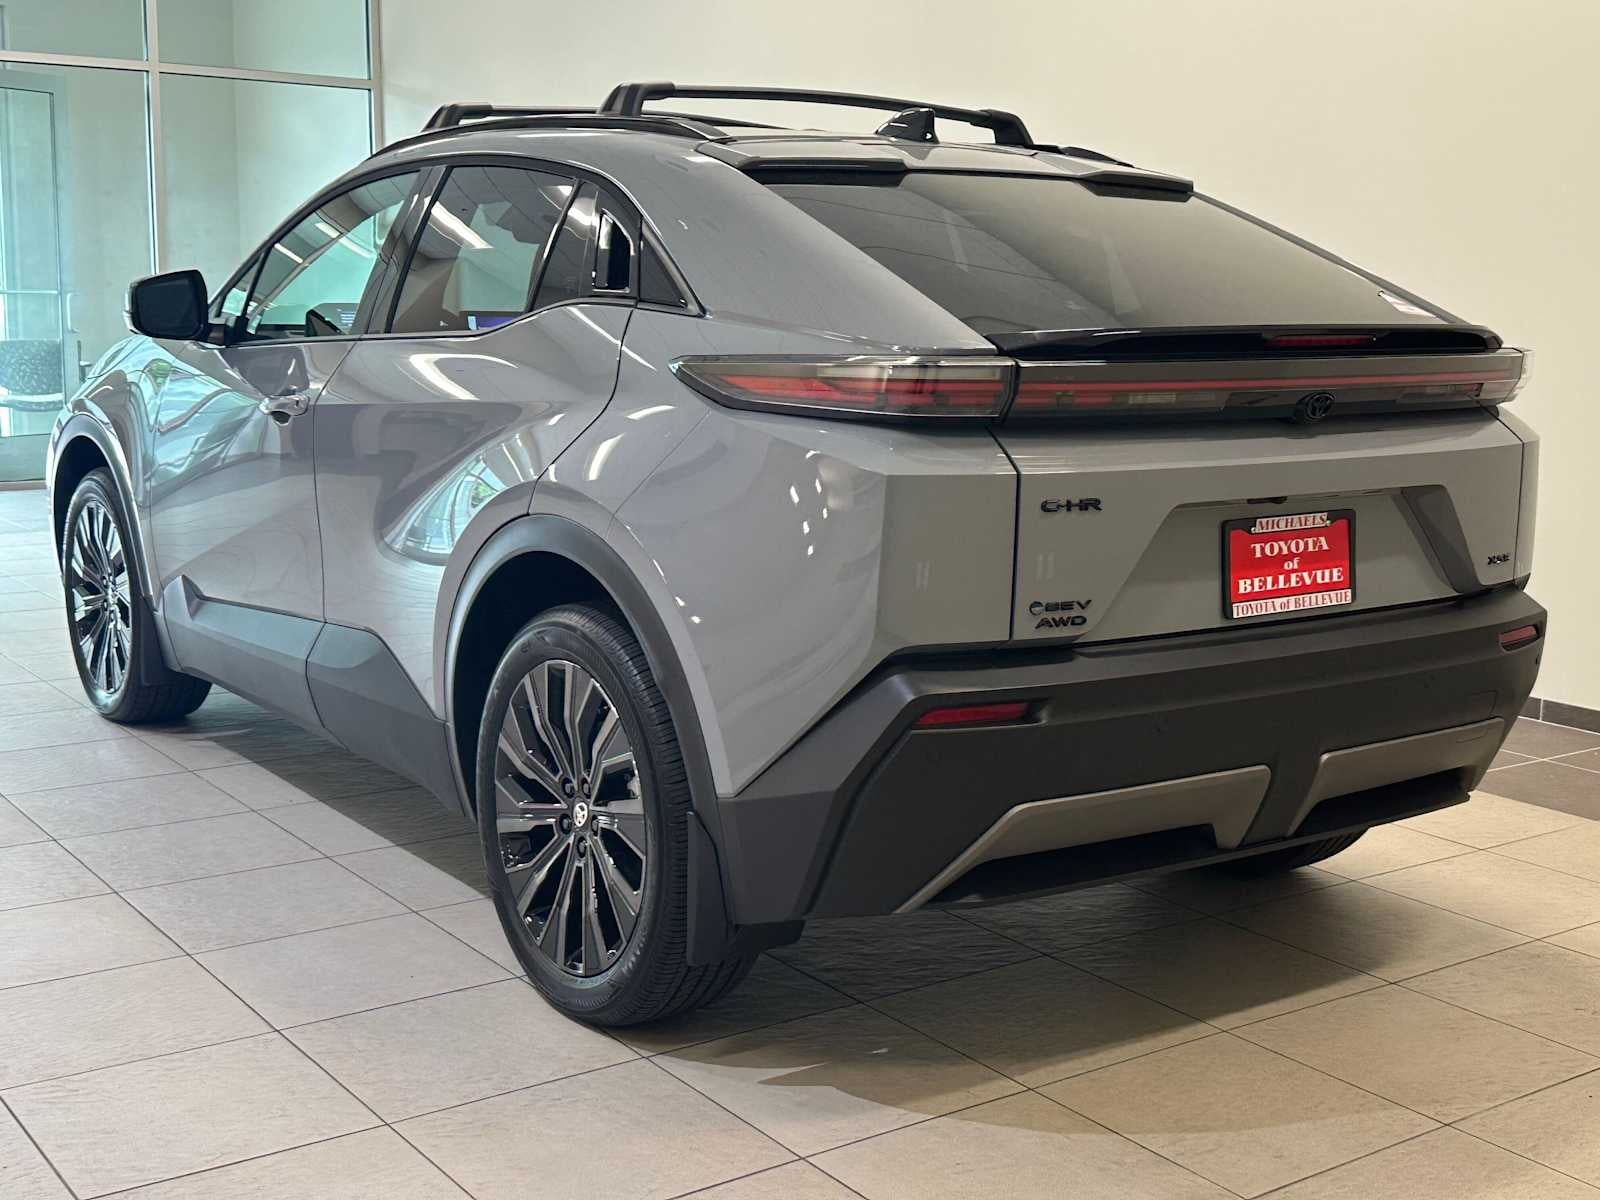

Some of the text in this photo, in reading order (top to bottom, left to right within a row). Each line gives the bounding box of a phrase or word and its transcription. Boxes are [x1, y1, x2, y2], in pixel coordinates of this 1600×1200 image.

[1040, 498, 1103, 512] C-HR
[1258, 514, 1326, 531] MICHAELS
[1251, 536, 1329, 558] TOYOTA
[1283, 557, 1301, 571] of
[1238, 567, 1344, 594] BELLEVUE
[1234, 591, 1350, 616] TOYOTA of BELLEVUE
[1035, 615, 1088, 630] AWD
